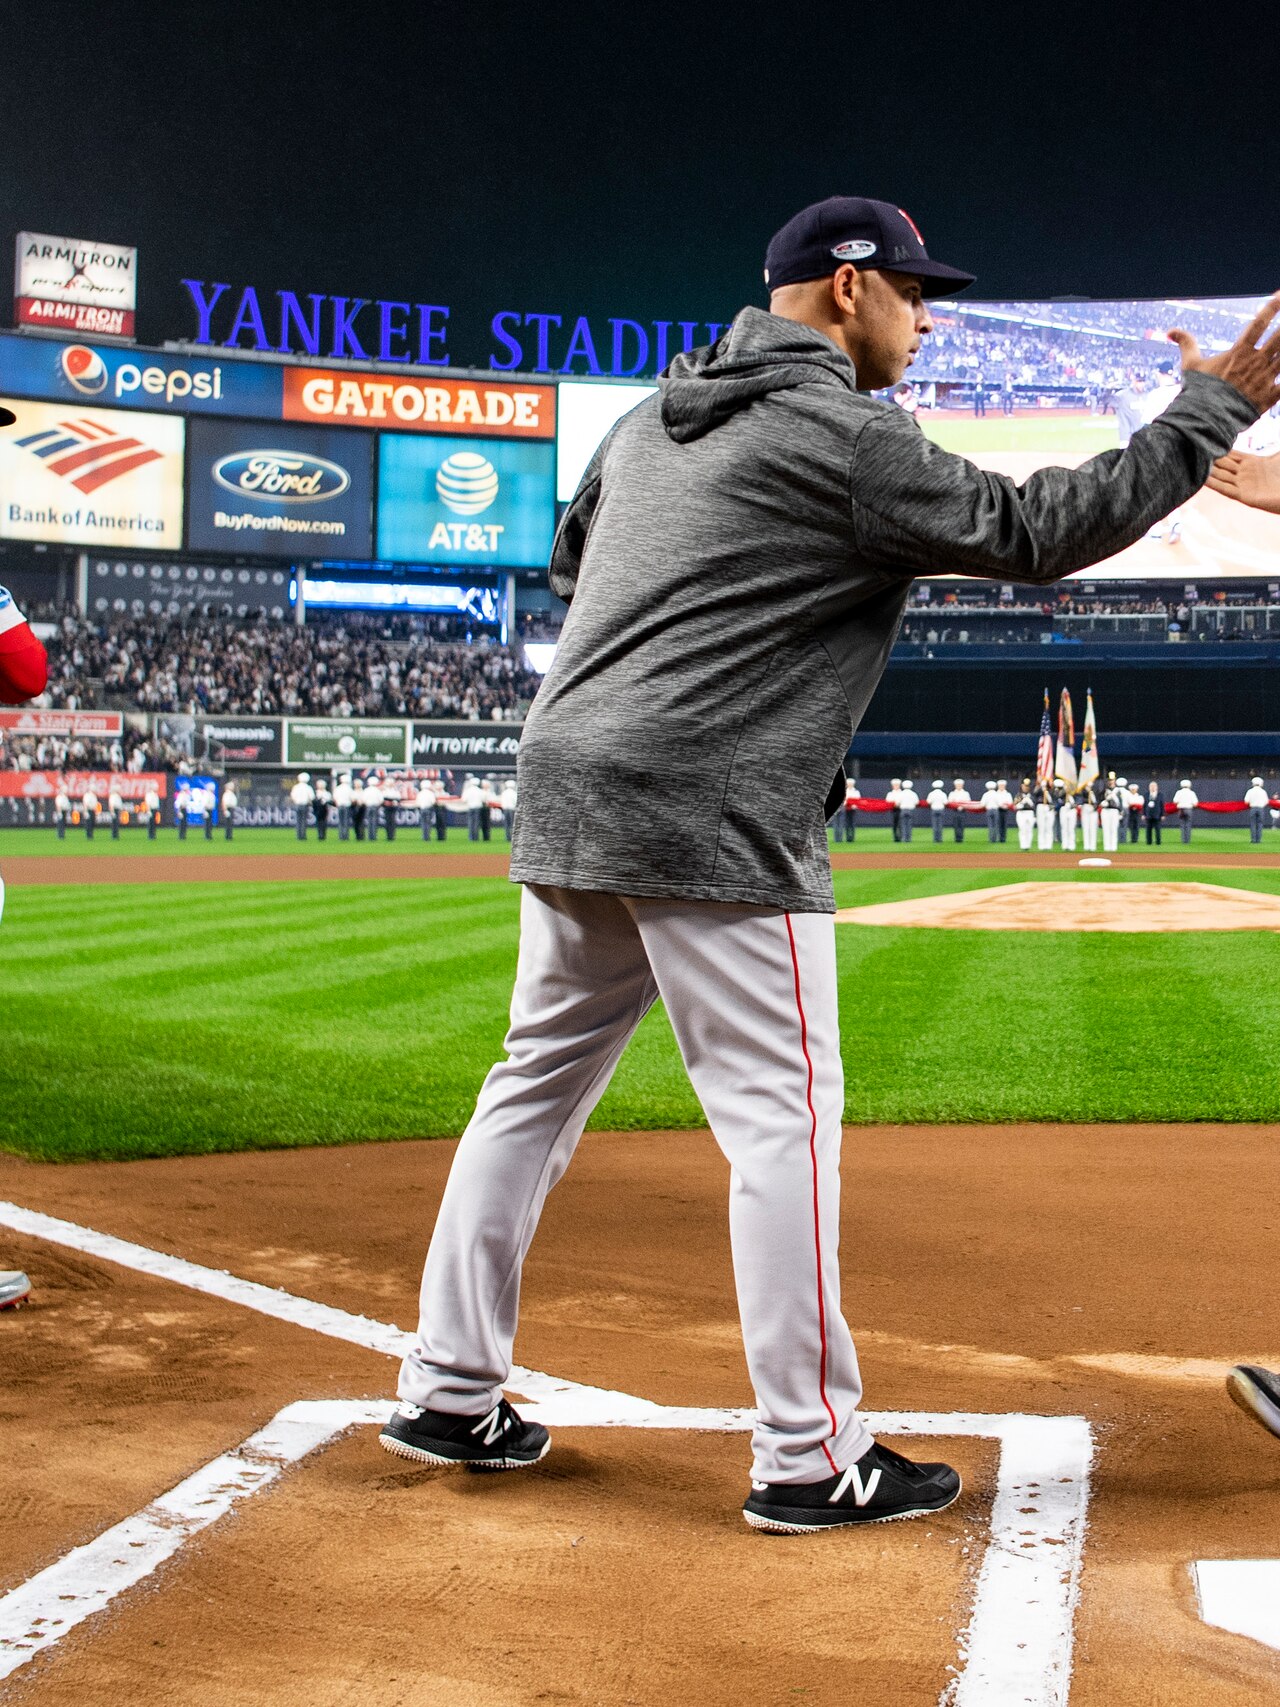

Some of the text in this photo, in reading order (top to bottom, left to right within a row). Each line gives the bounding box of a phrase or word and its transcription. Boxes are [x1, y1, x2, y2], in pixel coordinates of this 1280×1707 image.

[26, 243, 131, 270] ARMITRON
[29, 299, 124, 325] ARMITRON
[181, 278, 733, 379] YANKEE STADI
[115, 362, 223, 403] pepsi
[302, 379, 539, 427] GATORADE
[240, 458, 322, 496] Ford
[9, 504, 166, 532] Bank of America
[214, 511, 346, 535] BuyFordNow.com
[428, 523, 504, 552] AT&T
[203, 724, 275, 741] Panasonic
[232, 806, 298, 826] StubHub
[828, 1463, 883, 1507] N
